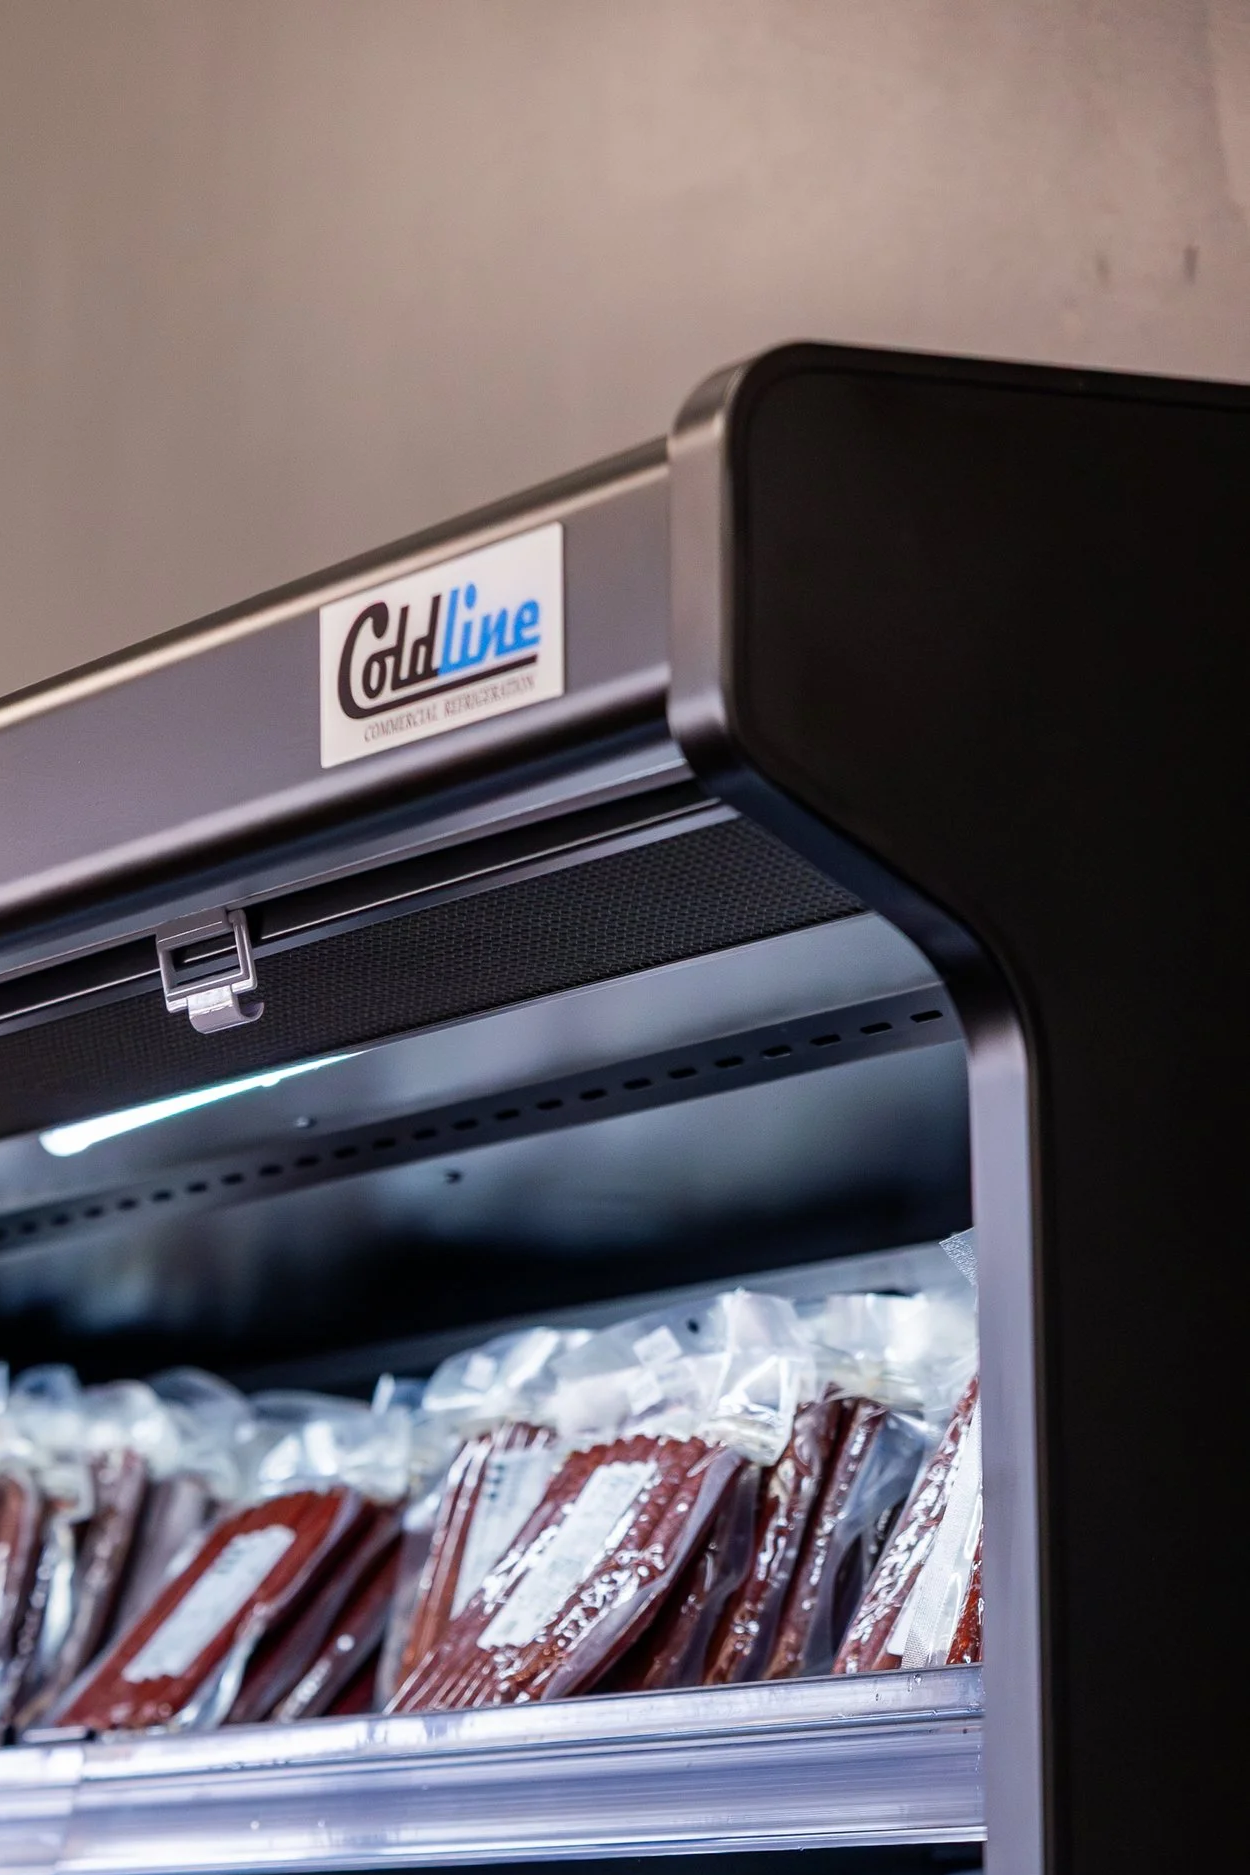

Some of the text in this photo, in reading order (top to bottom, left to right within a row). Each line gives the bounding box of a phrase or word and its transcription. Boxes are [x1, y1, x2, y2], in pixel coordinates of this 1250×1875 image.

[338, 582, 540, 719] Coldline
[364, 675, 536, 742] COMMERCIAL REFRIGERATION
